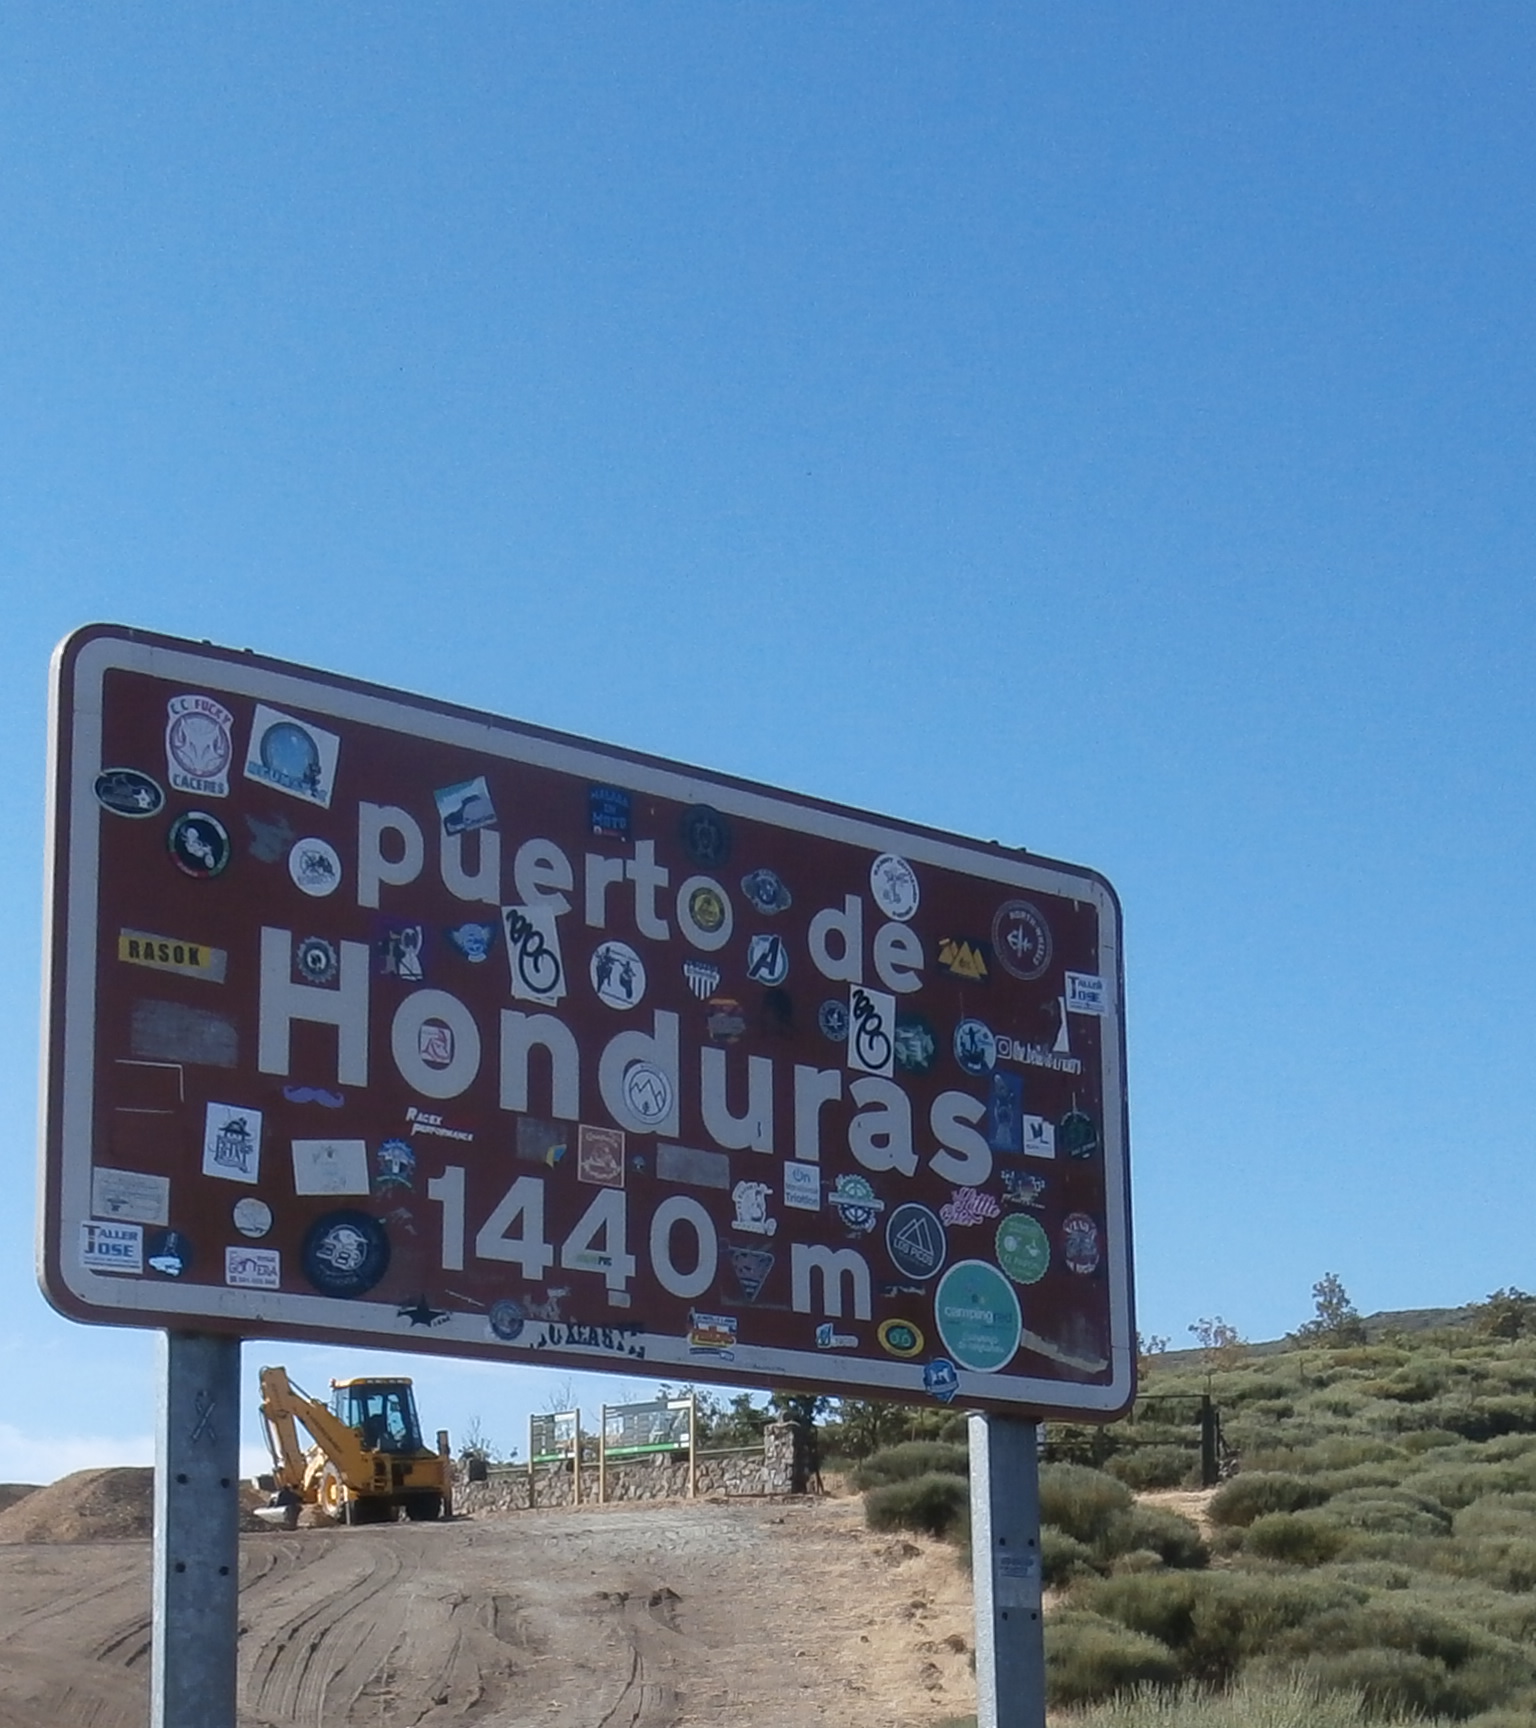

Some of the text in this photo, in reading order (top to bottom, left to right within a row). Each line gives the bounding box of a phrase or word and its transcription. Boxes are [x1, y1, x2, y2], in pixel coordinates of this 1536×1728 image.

[128, 938, 202, 967] RASOK
[357, 800, 734, 952] puerto
[808, 893, 925, 994] de
[258, 925, 993, 1187] Honduras
[427, 1164, 718, 1299] 1440
[790, 1242, 872, 1322] m
[893, 1237, 934, 1268] LOS PICOS
